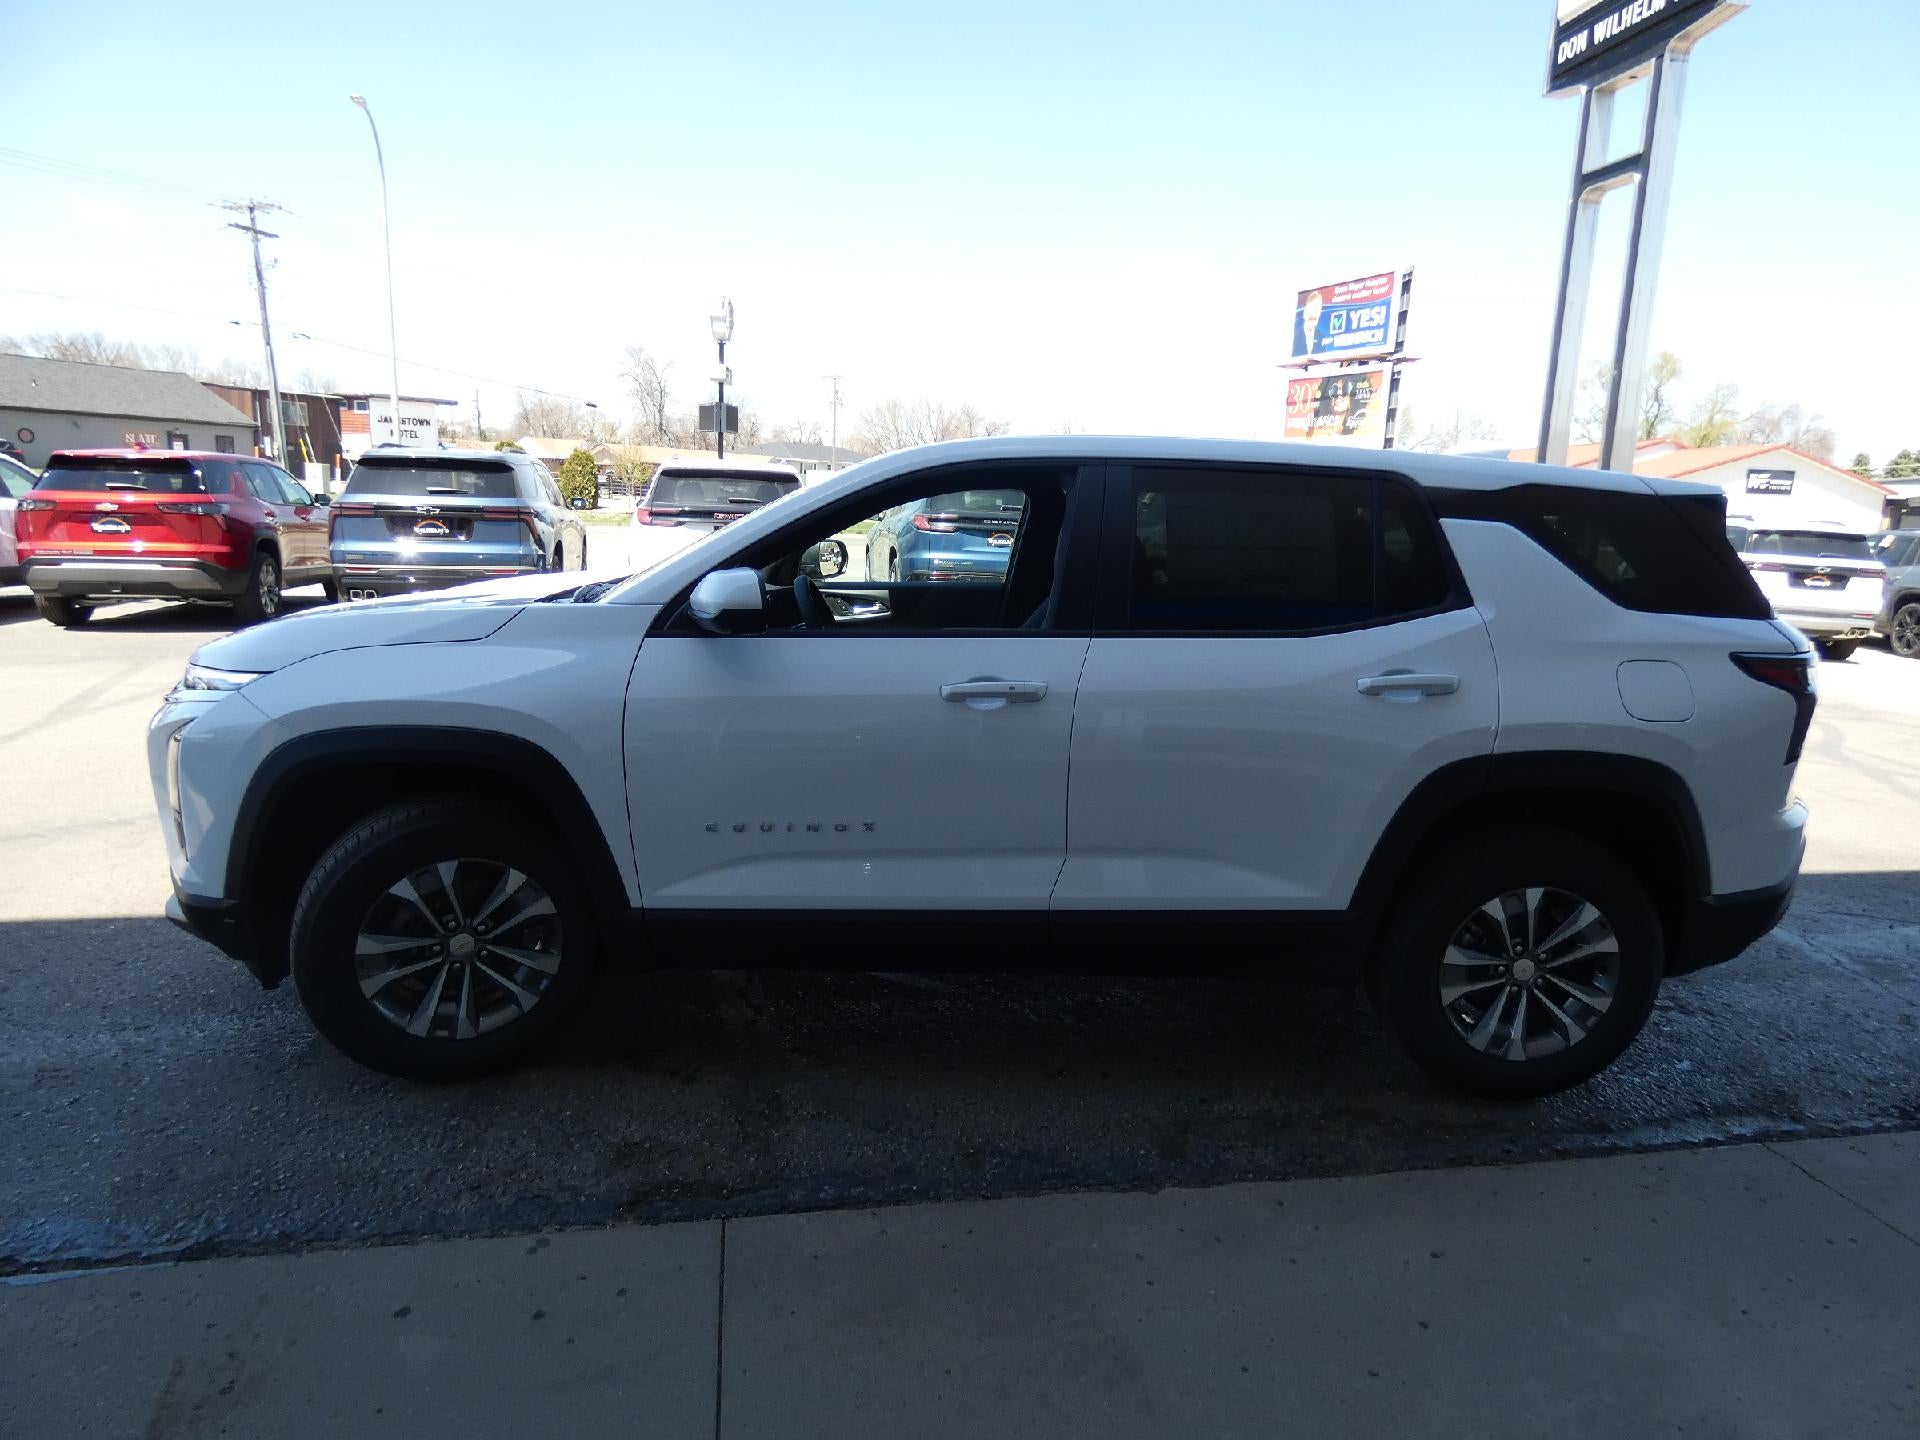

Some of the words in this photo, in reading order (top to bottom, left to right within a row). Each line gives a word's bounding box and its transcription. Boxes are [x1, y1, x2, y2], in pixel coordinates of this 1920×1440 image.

[1558, 29, 1588, 64] DON
[1594, 0, 1666, 45] WILHELM
[1350, 305, 1386, 330] YES!
[377, 415, 431, 426] JASTOWN
[390, 428, 419, 439] OTEL
[704, 821, 874, 833] EQUINOX
